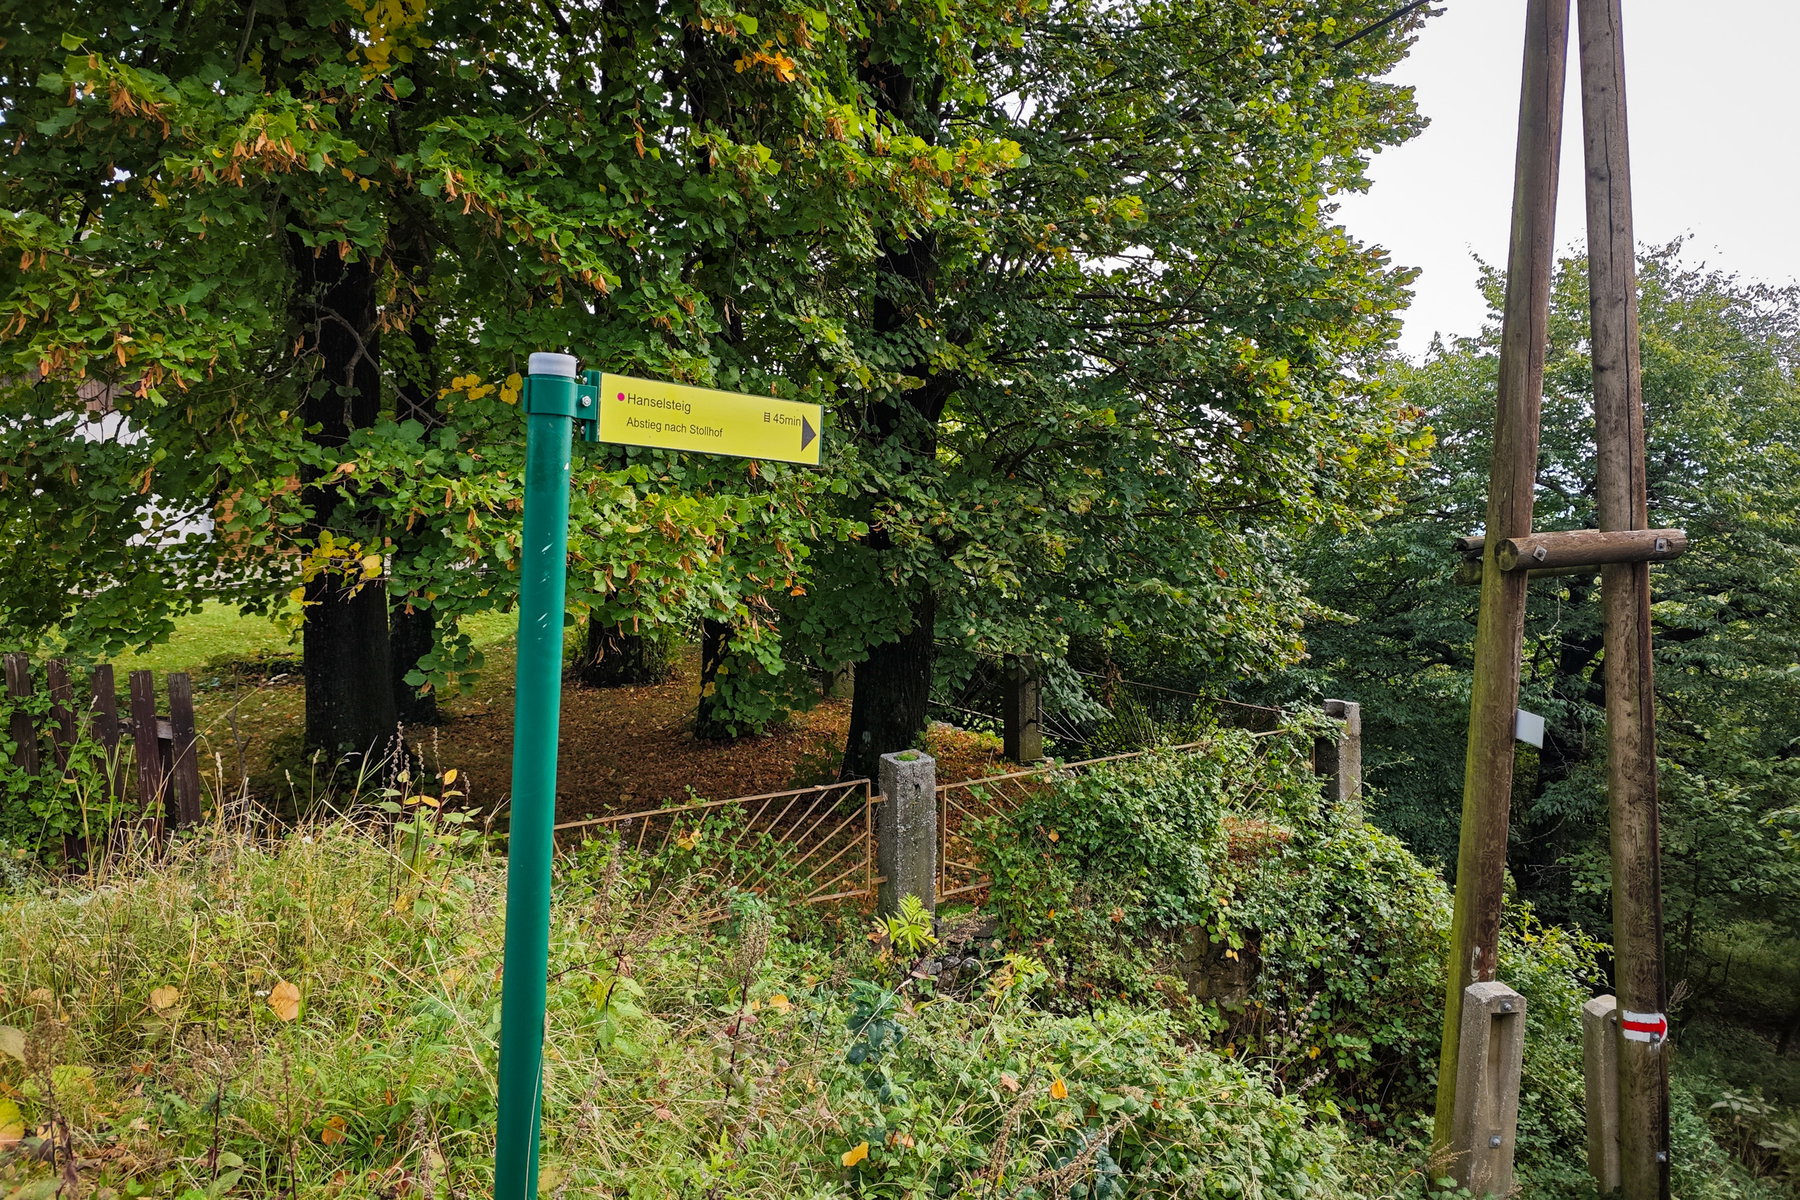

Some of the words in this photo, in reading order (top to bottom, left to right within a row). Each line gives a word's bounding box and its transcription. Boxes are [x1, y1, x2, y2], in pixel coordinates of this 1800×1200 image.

[627, 392, 692, 414] Hanselsteig
[626, 416, 662, 433] Abstieg
[664, 423, 687, 434] nach
[689, 424, 724, 438] Stollhof
[772, 413, 802, 427] 45min
